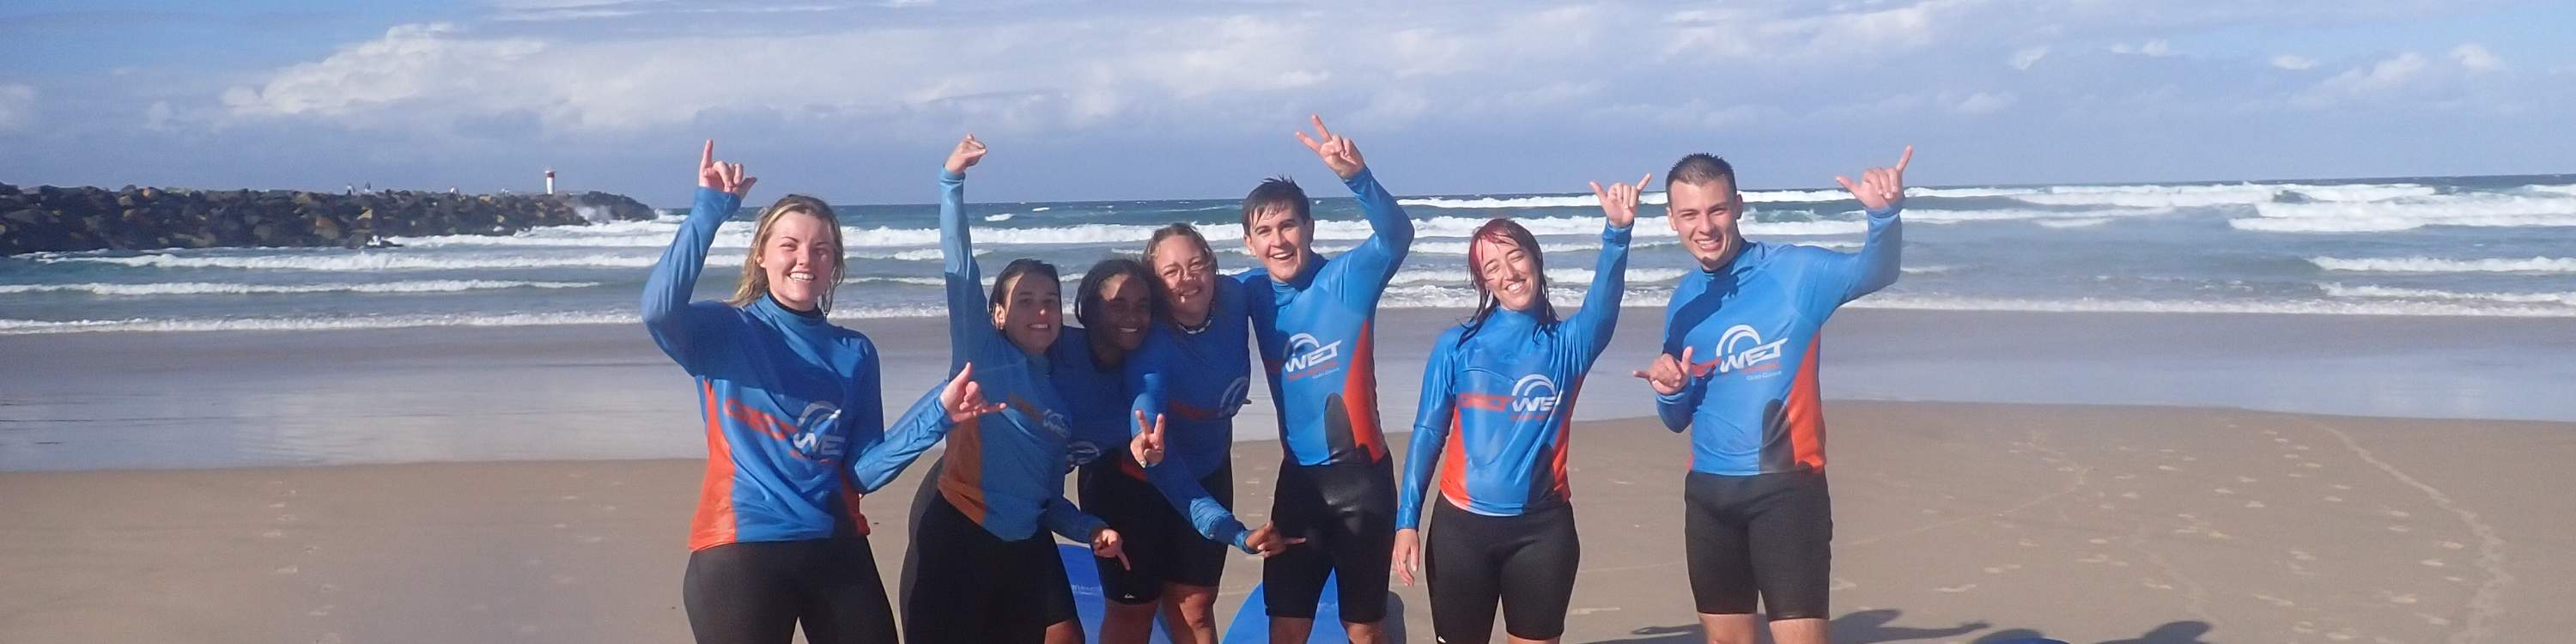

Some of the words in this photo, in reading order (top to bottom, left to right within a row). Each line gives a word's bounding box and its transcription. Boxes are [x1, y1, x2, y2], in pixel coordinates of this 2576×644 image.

[1285, 339, 1342, 373] WET
[1720, 337, 1789, 373] WET
[1511, 396, 1557, 412] WE
